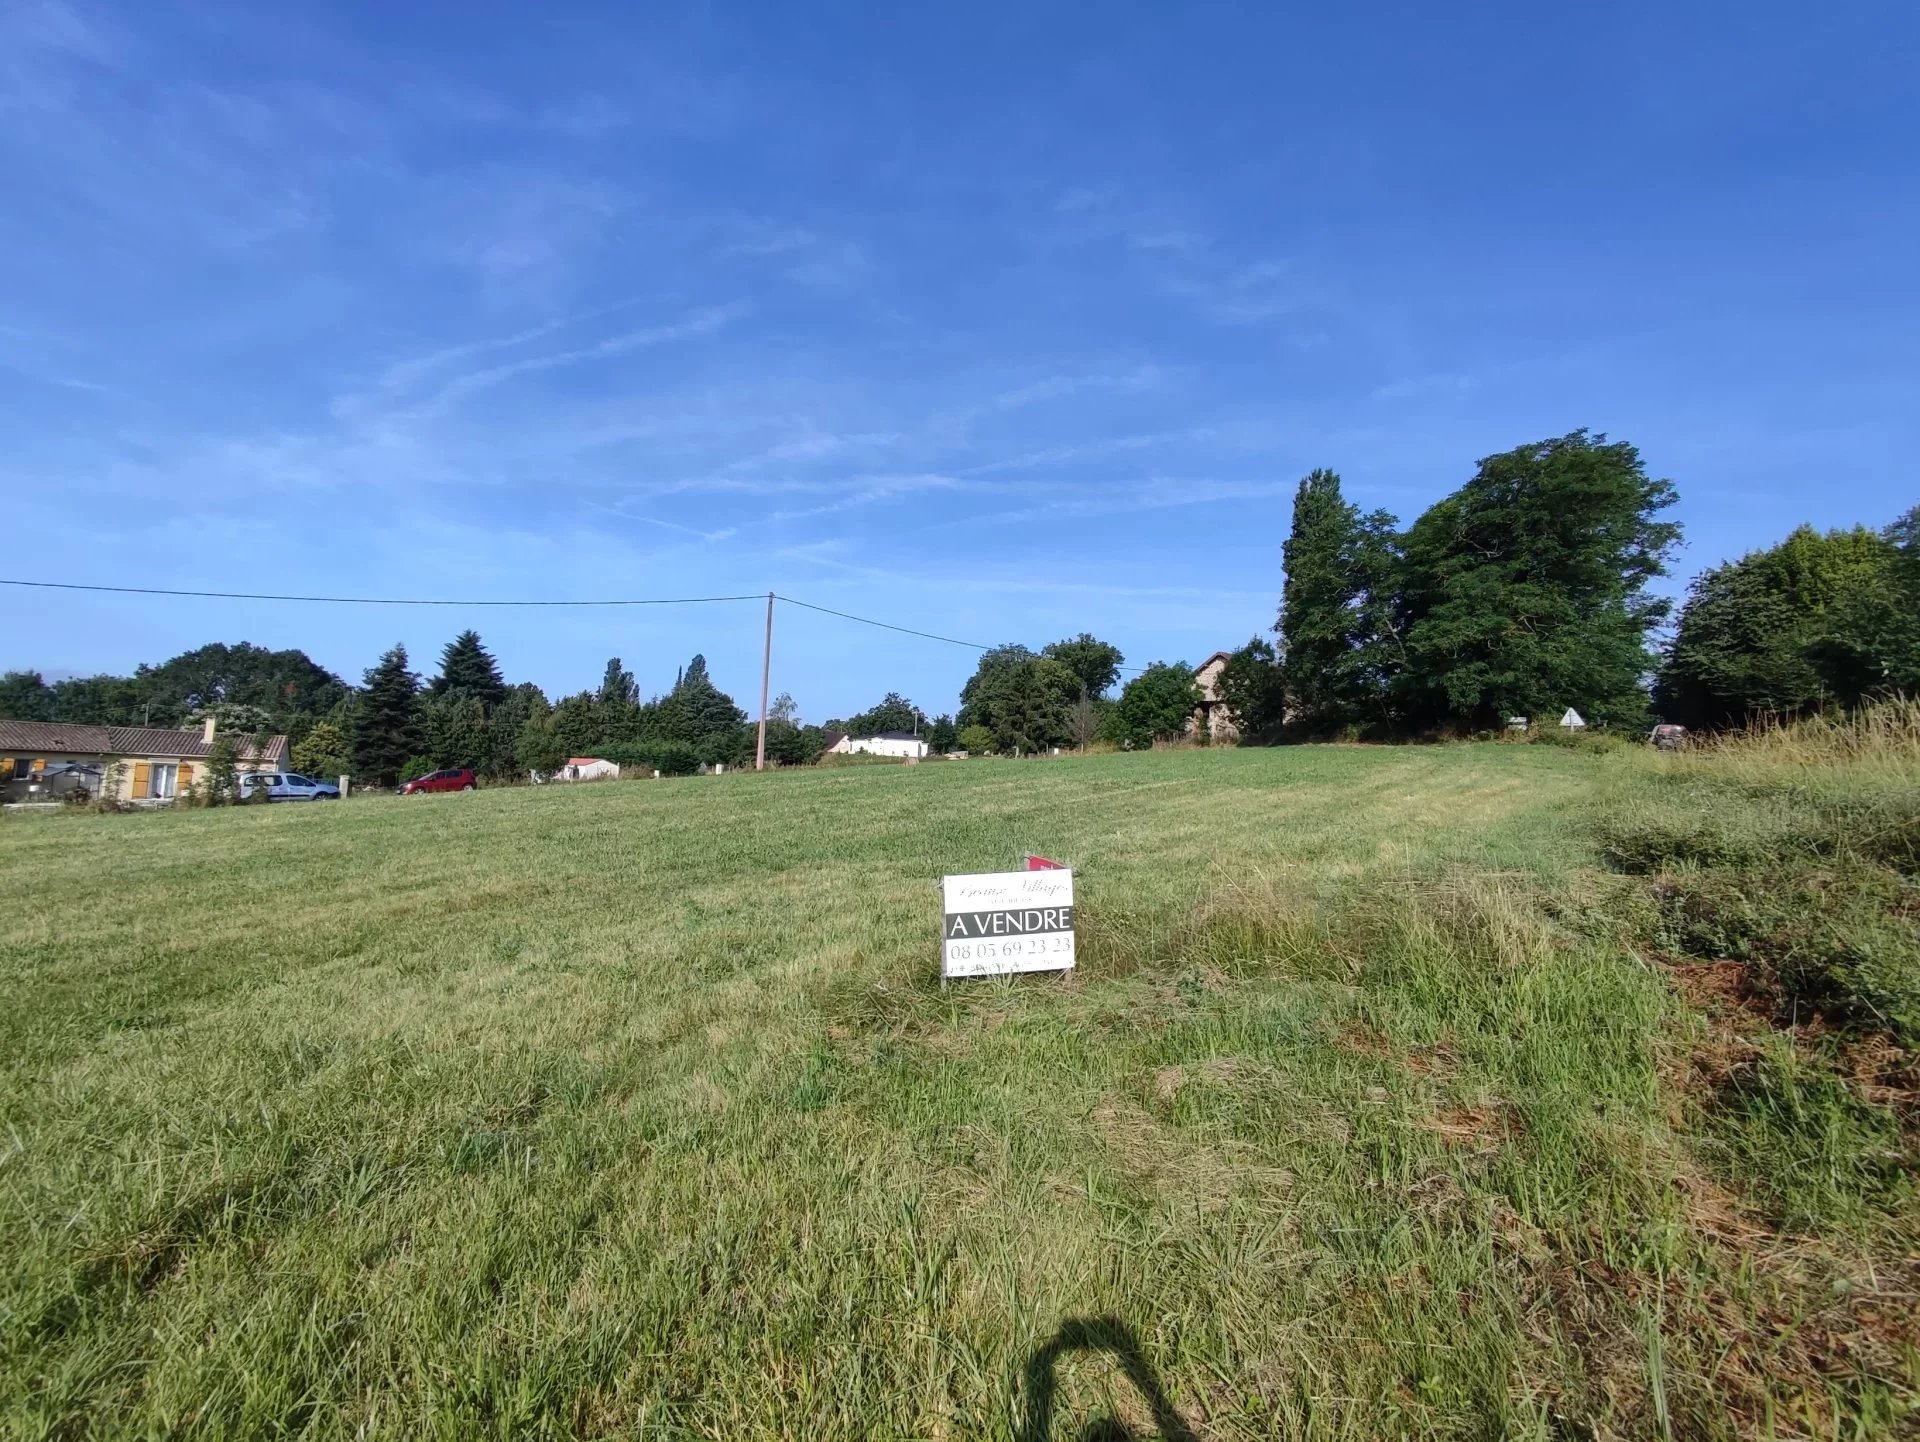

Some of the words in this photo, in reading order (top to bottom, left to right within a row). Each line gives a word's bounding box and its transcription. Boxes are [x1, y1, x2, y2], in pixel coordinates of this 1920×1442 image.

[950, 915, 968, 937] A
[973, 908, 1070, 935] VENDRE
[950, 945, 971, 959] 08
[976, 943, 996, 958] 05
[1002, 941, 1022, 956] 69
[1028, 939, 1046, 954] 23
[1053, 937, 1071, 952] 23
